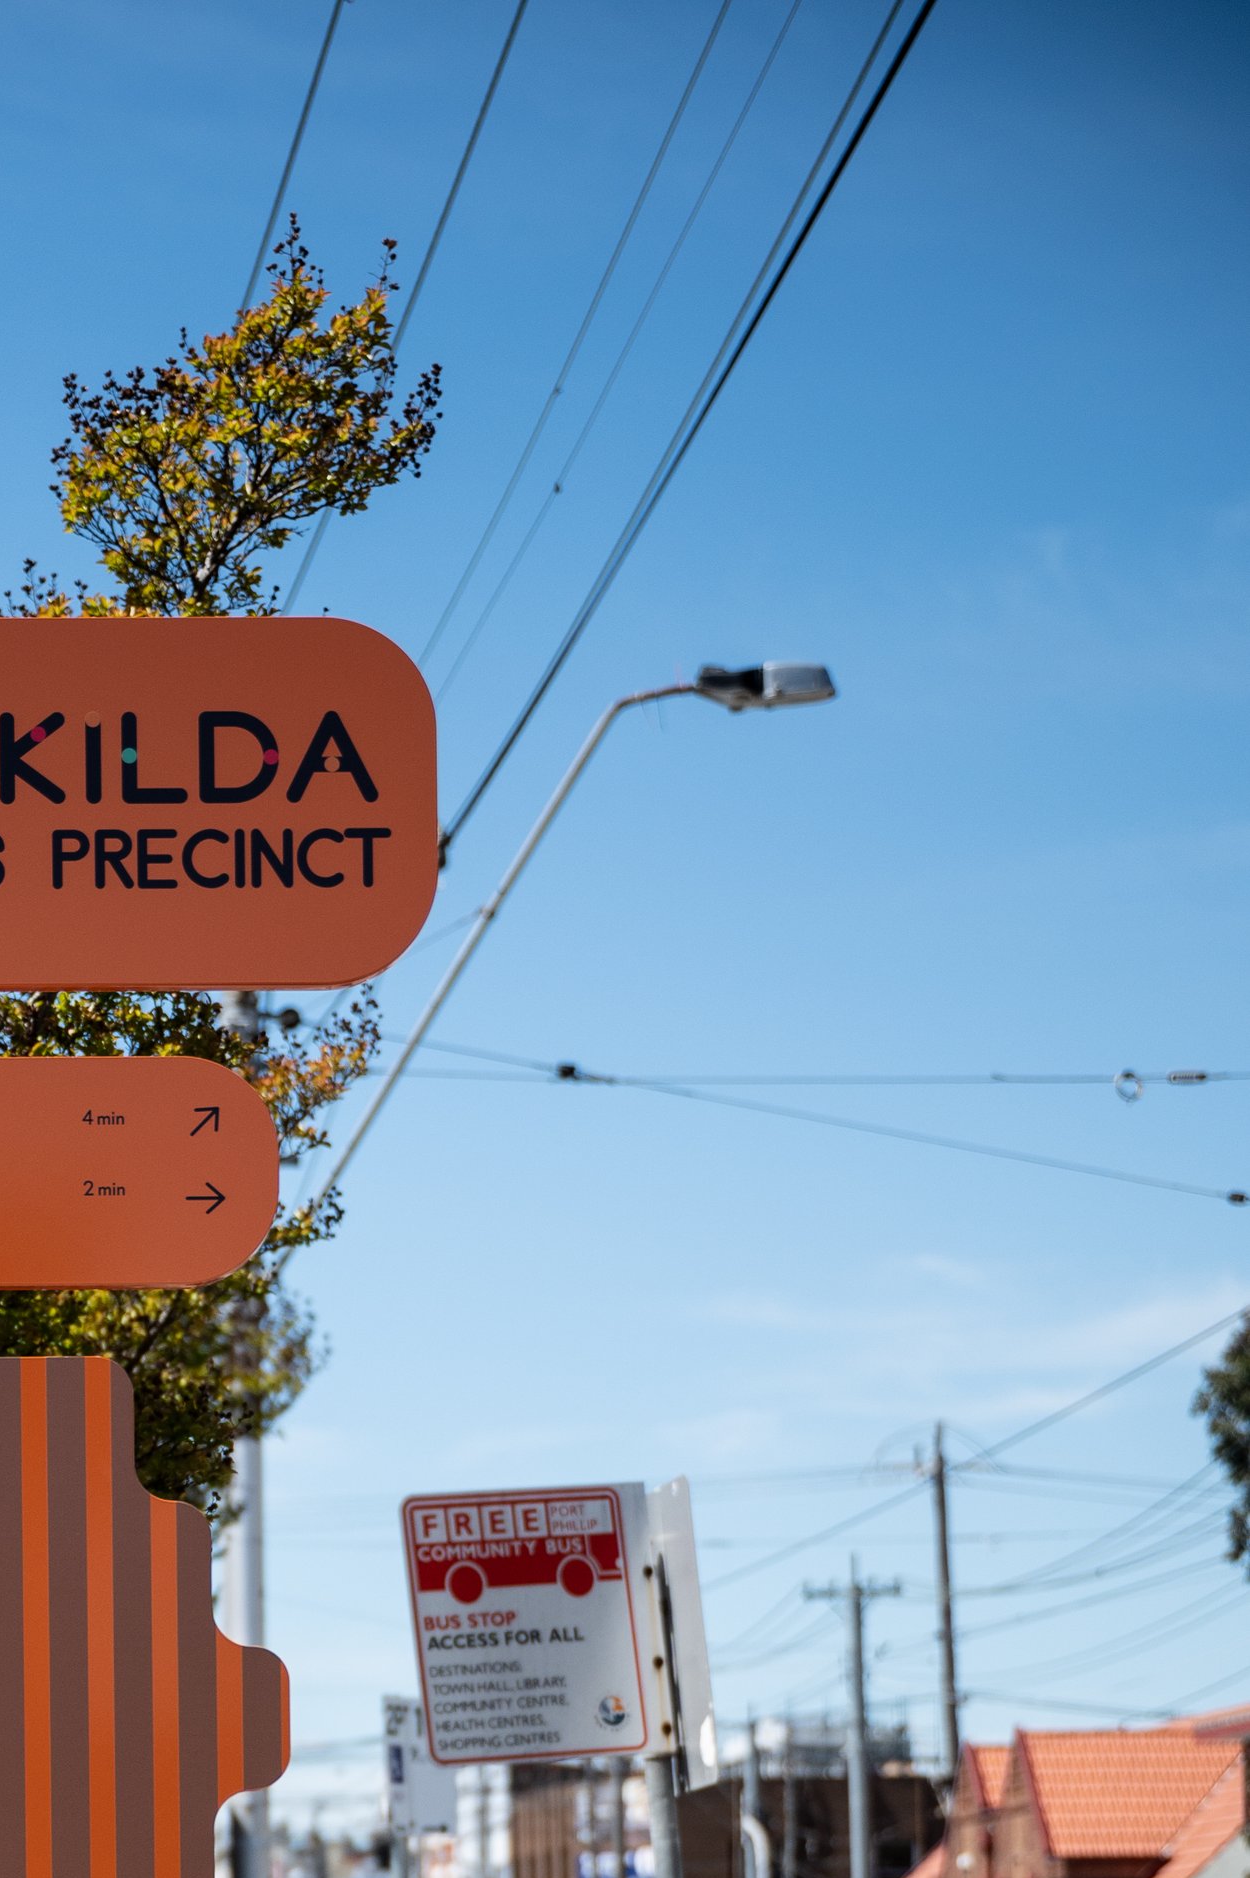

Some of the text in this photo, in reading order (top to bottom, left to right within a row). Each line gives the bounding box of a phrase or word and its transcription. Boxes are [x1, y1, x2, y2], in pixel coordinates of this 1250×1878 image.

[51, 827, 392, 890] PRECINCT
[82, 1109, 125, 1125] 4 min
[83, 1180, 126, 1196] 2 min
[550, 1504, 585, 1517] PORT
[421, 1508, 539, 1538] FREE
[417, 1537, 582, 1562] COMMUNITY BUS
[424, 1611, 516, 1631] BUS STOP
[427, 1627, 584, 1650] ACCESS FOR ALL
[433, 1683, 475, 1695] TOWN
[434, 1698, 512, 1715] COMMUNITY
[436, 1716, 485, 1732] HEALTH
